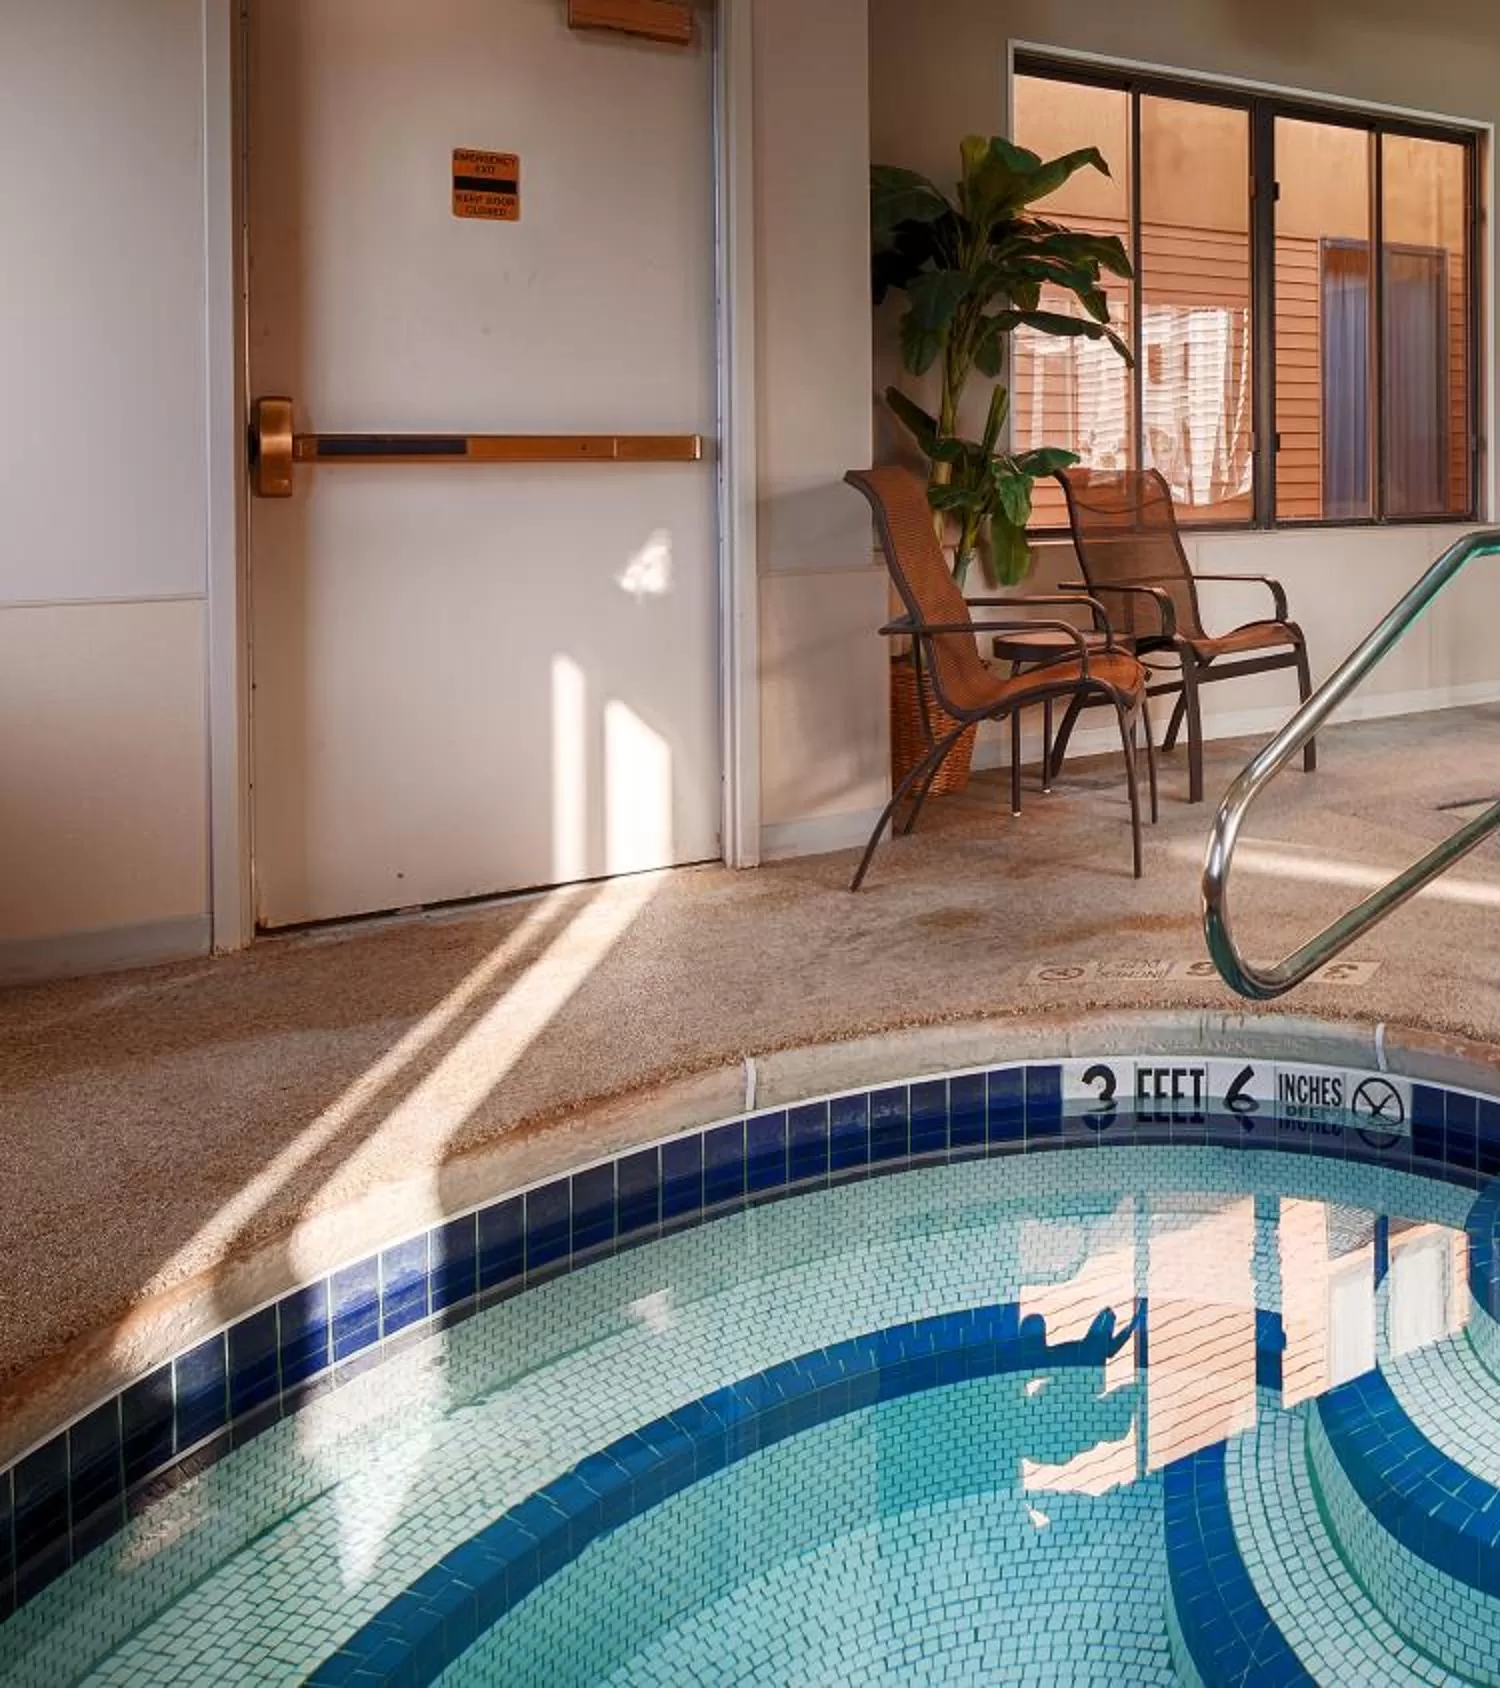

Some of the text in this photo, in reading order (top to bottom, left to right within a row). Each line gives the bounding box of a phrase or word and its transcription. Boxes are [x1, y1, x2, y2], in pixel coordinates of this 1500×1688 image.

[1081, 1064, 1117, 1114] 3
[1224, 1064, 1257, 1112] 6
[1279, 1073, 1343, 1107] INCHES
